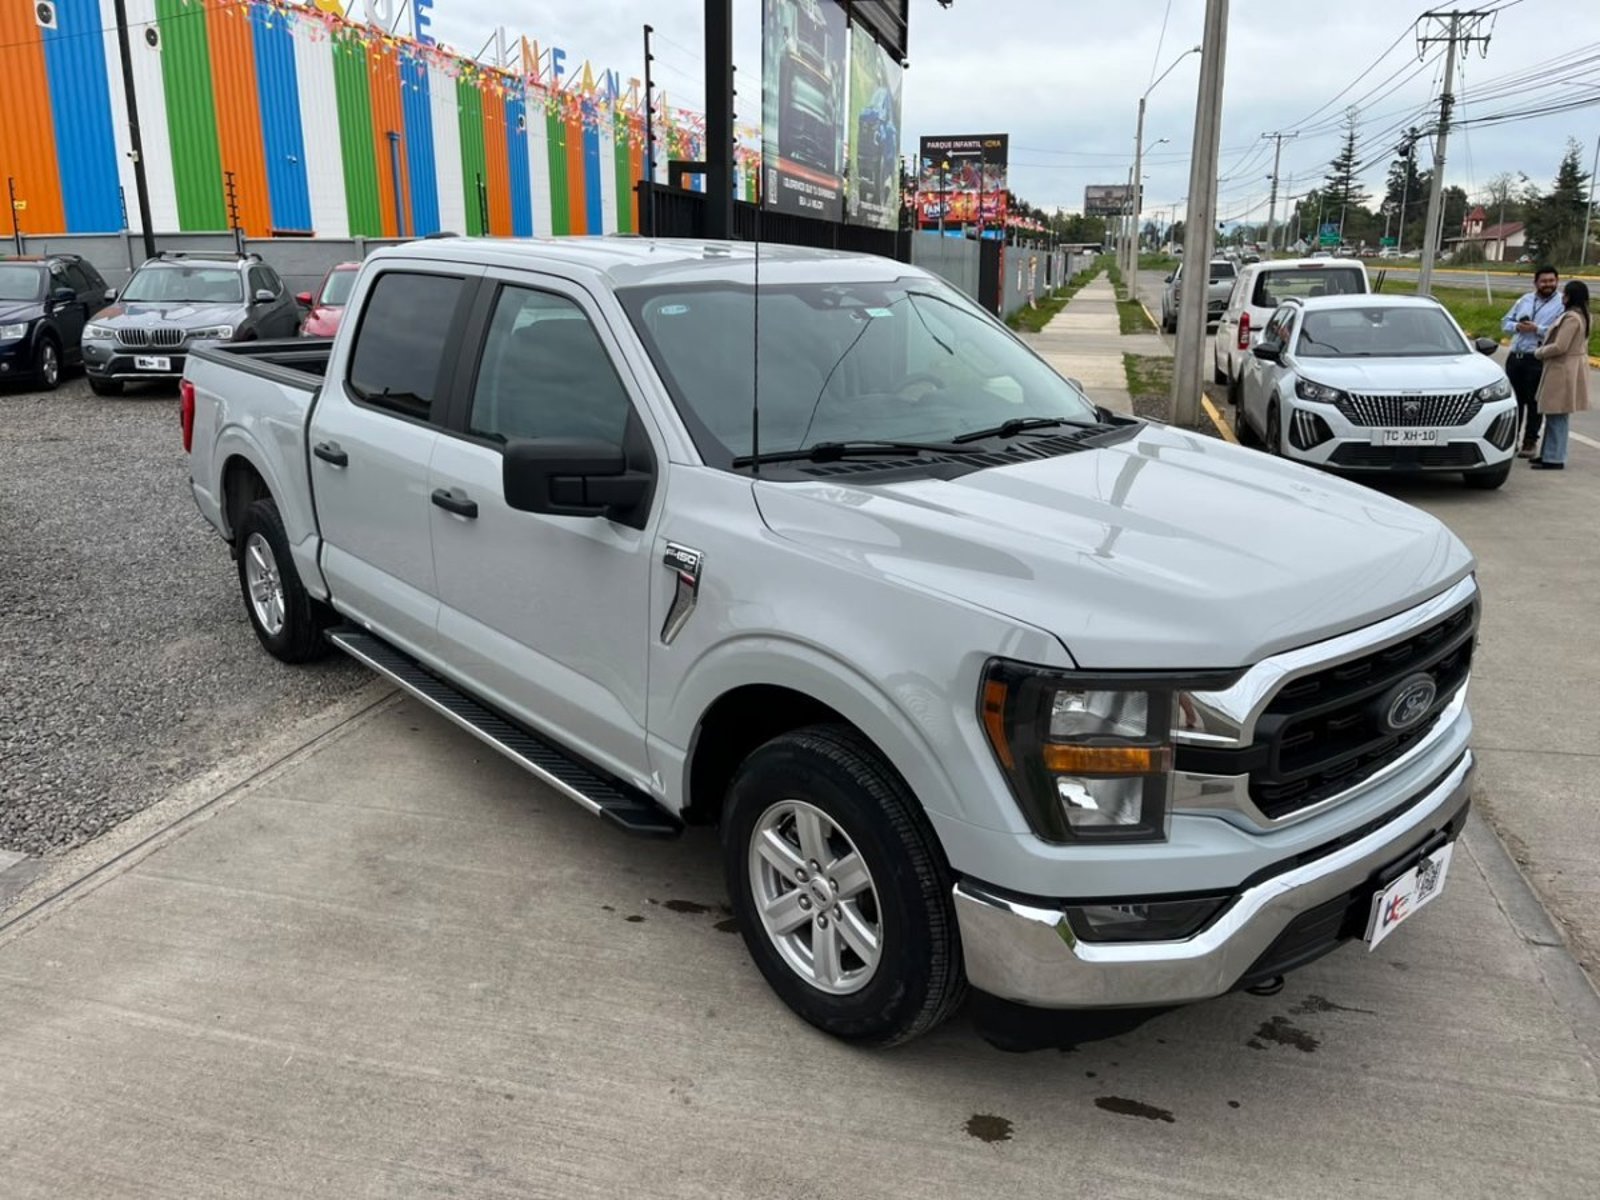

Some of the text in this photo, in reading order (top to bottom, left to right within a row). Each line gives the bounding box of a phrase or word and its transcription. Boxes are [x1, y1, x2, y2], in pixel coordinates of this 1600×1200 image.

[927, 141, 952, 149] PARQUE
[953, 141, 981, 149] INFANTIL
[1384, 430, 1399, 441] TC
